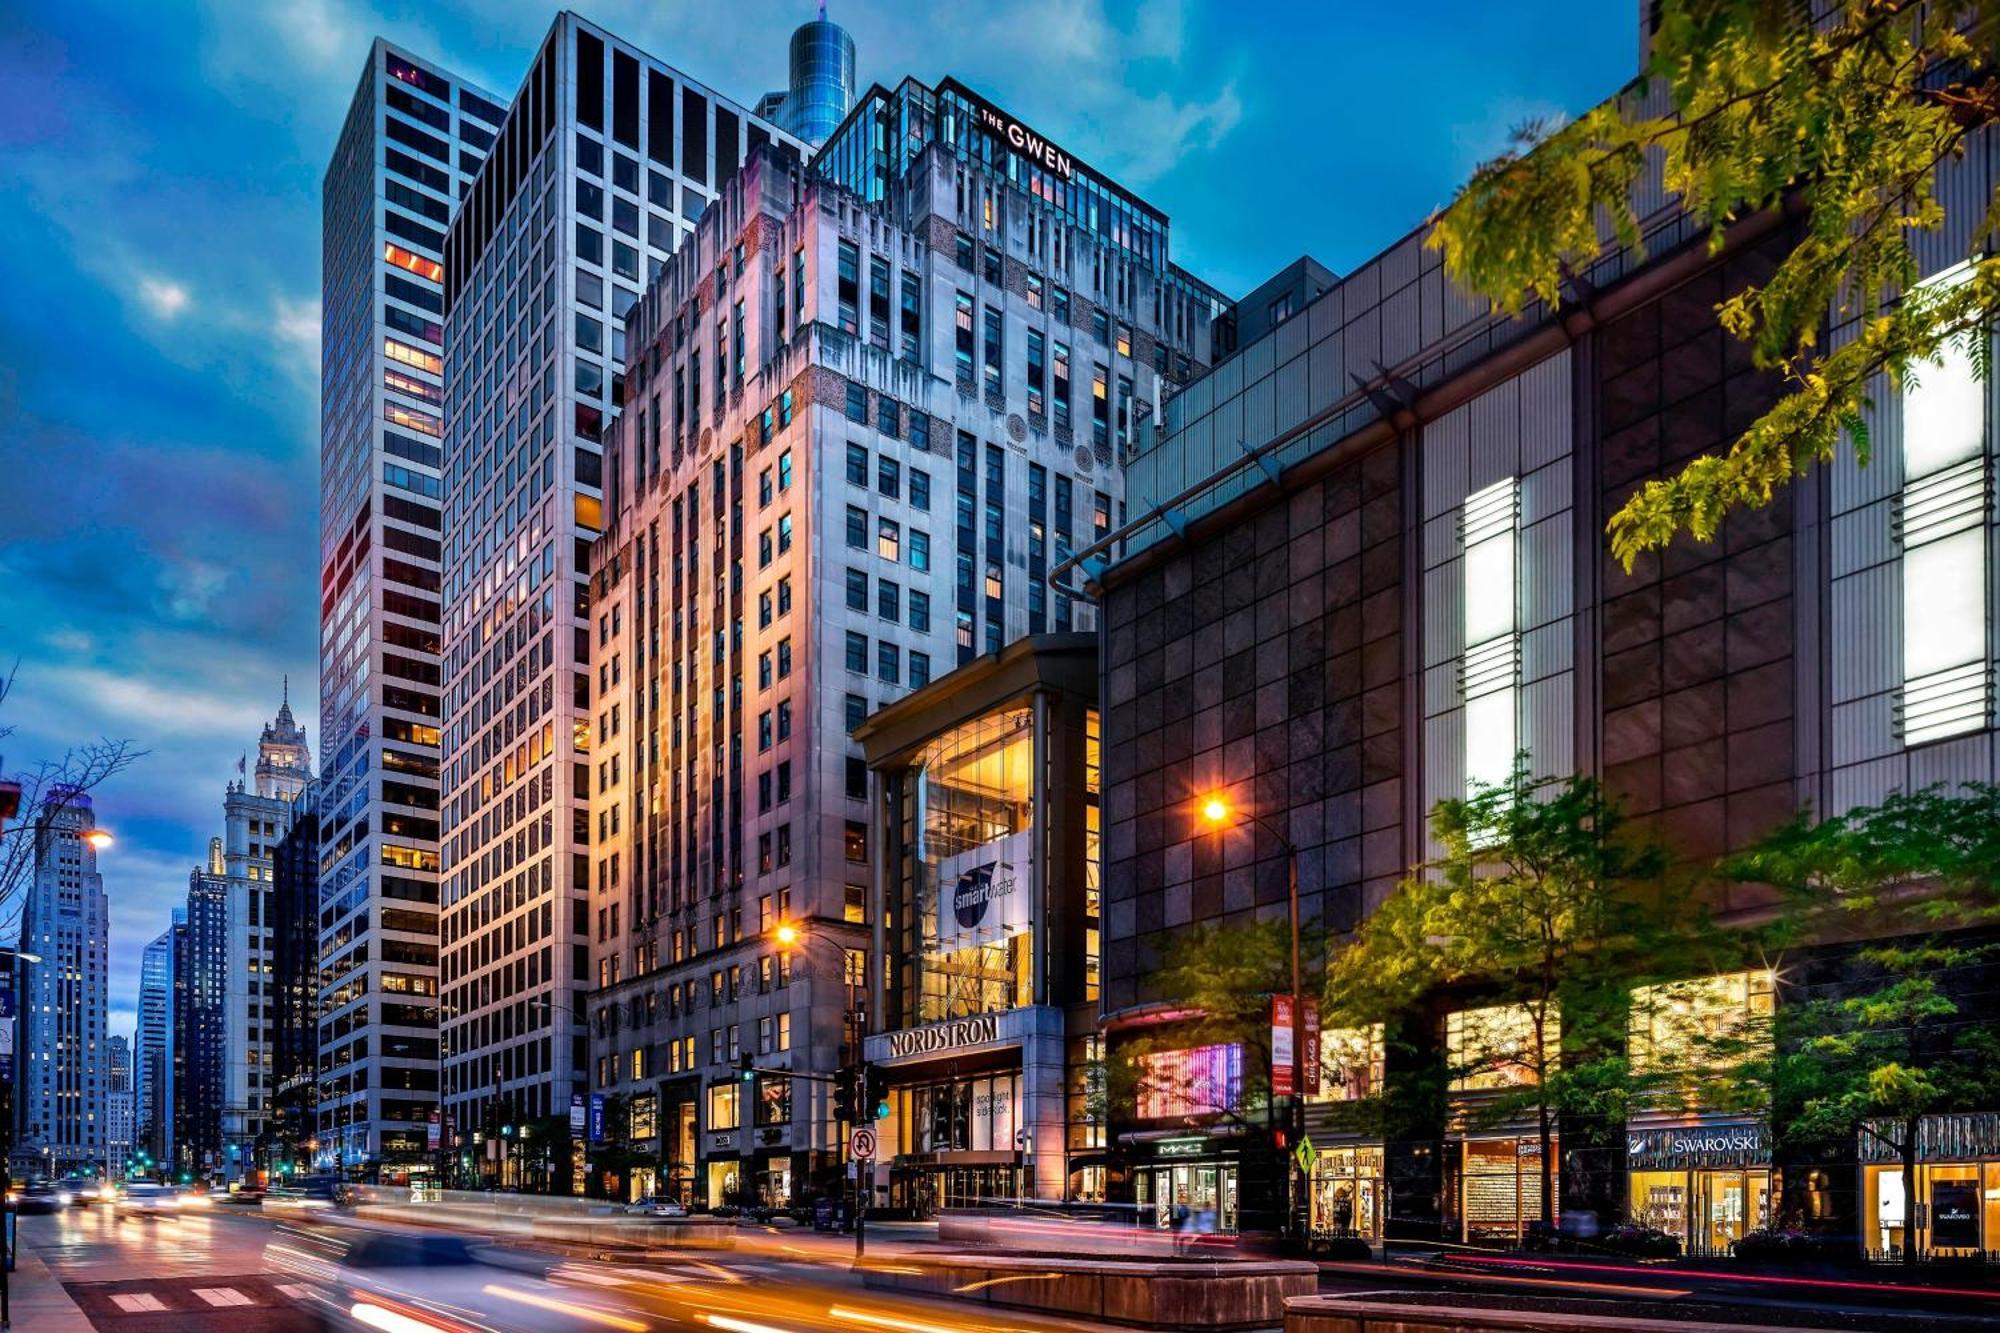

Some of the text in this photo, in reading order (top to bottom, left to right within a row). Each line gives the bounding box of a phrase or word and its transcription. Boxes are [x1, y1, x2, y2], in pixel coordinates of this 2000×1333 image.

[982, 109, 1070, 177] THE GWEN
[955, 877, 1016, 910] smartwater
[890, 1015, 999, 1058] NORDSTROM
[1308, 1039, 1316, 1085] CHICAGO
[1674, 1136, 1759, 1153] SWAROVSKI
